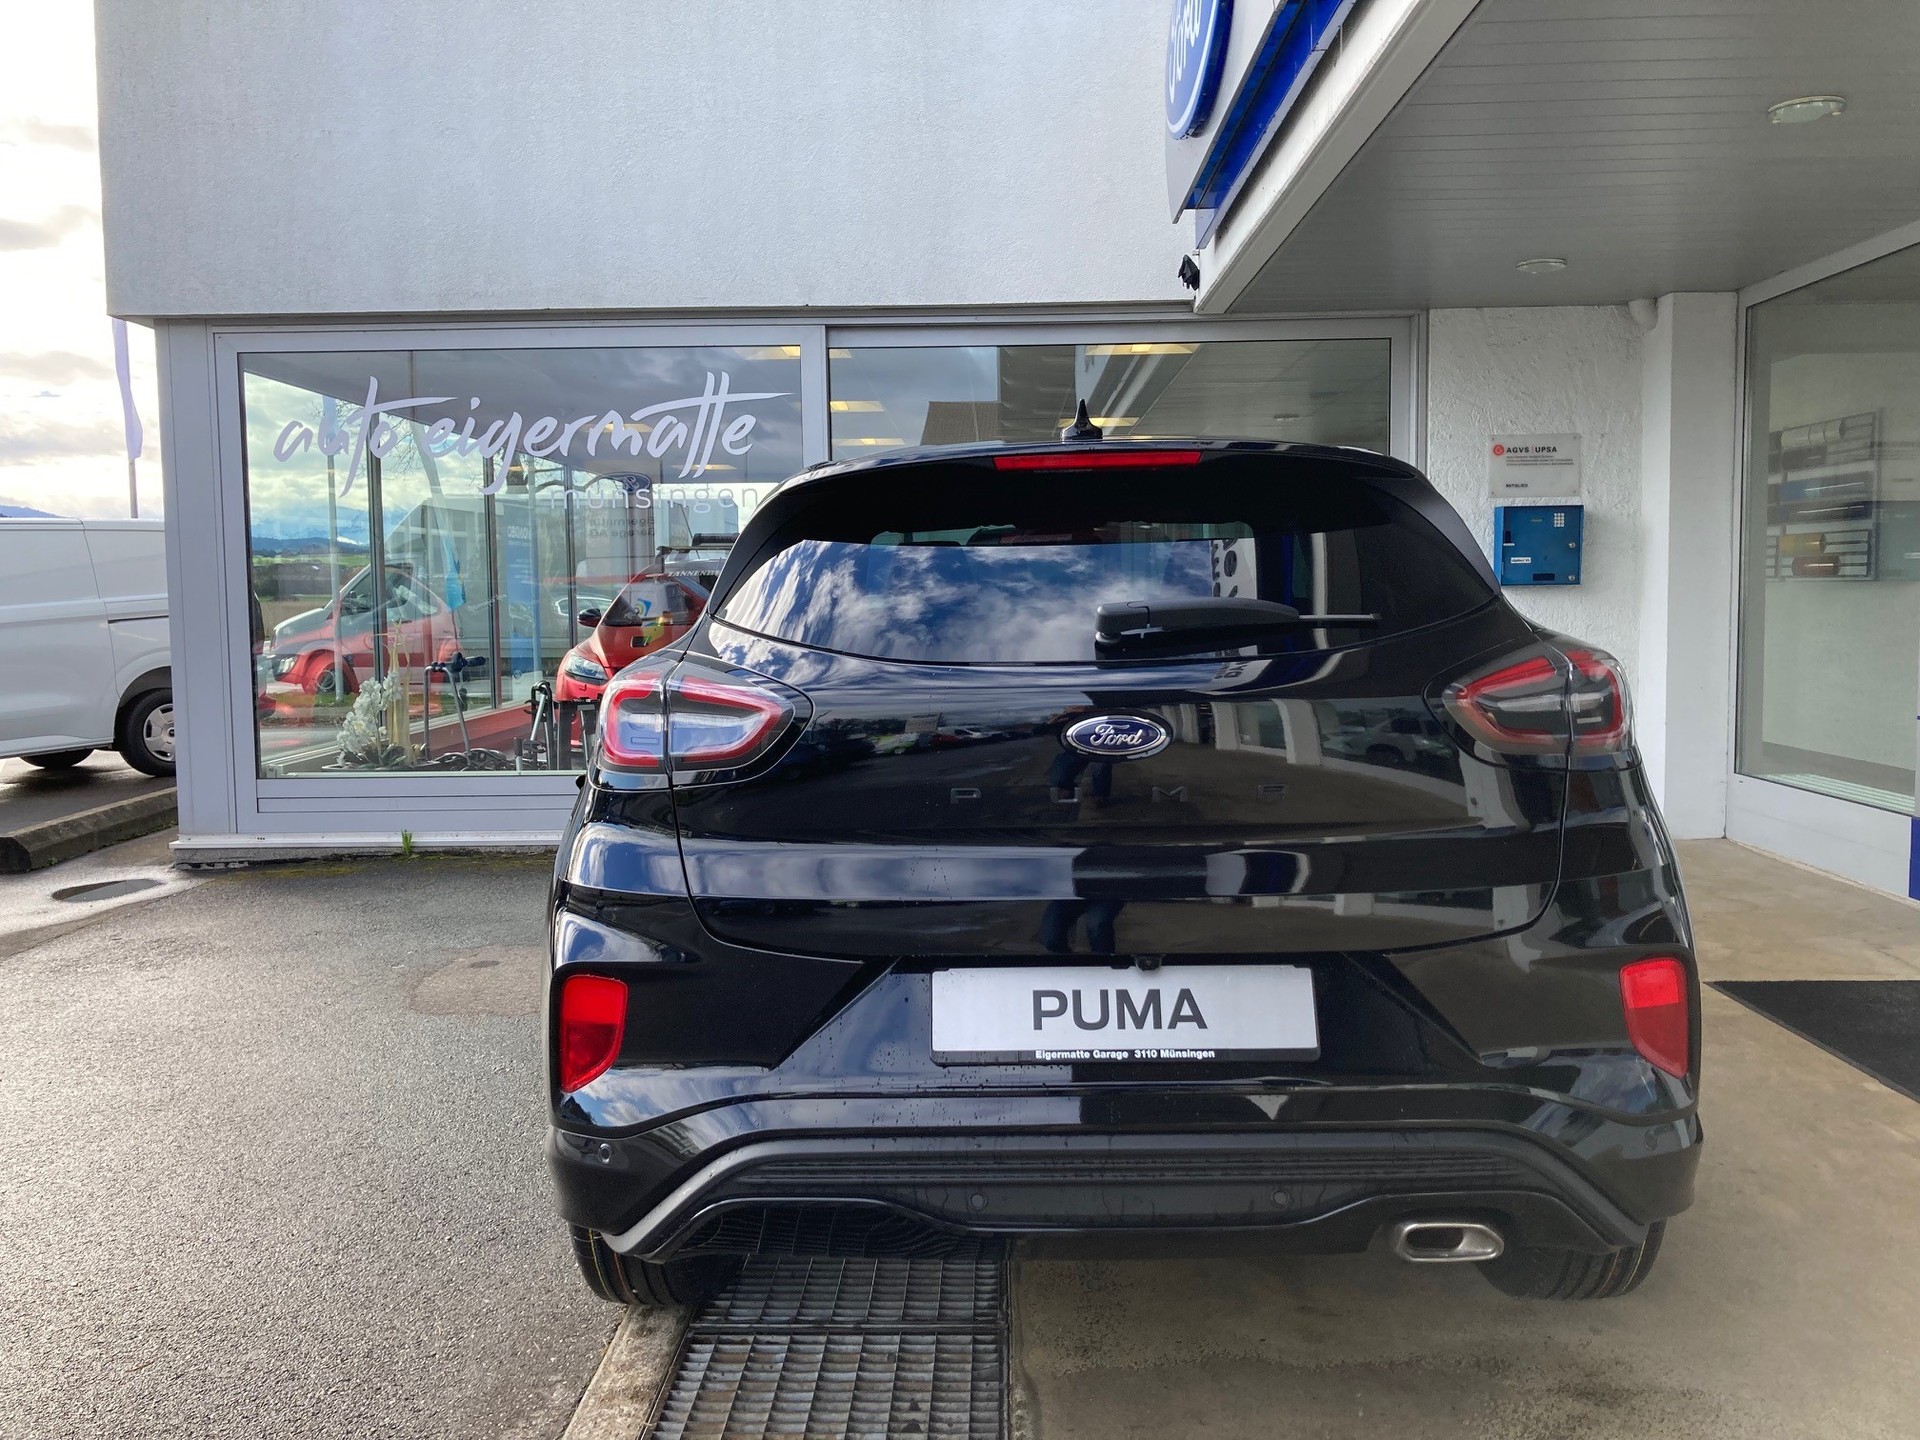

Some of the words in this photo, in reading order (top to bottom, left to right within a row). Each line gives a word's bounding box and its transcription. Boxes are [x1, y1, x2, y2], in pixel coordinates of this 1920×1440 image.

[272, 375, 458, 498] auto
[424, 370, 795, 496] eigermatte
[1506, 446, 1530, 454] AGVS
[1535, 445, 1558, 453] UPSA
[1090, 723, 1143, 746] Ford
[1032, 988, 1208, 1031] PUMA
[1035, 1050, 1090, 1060] Eigermatte
[1093, 1050, 1129, 1060] Garage
[1134, 1050, 1158, 1059] 3110
[1160, 1049, 1215, 1060] Münsingen
